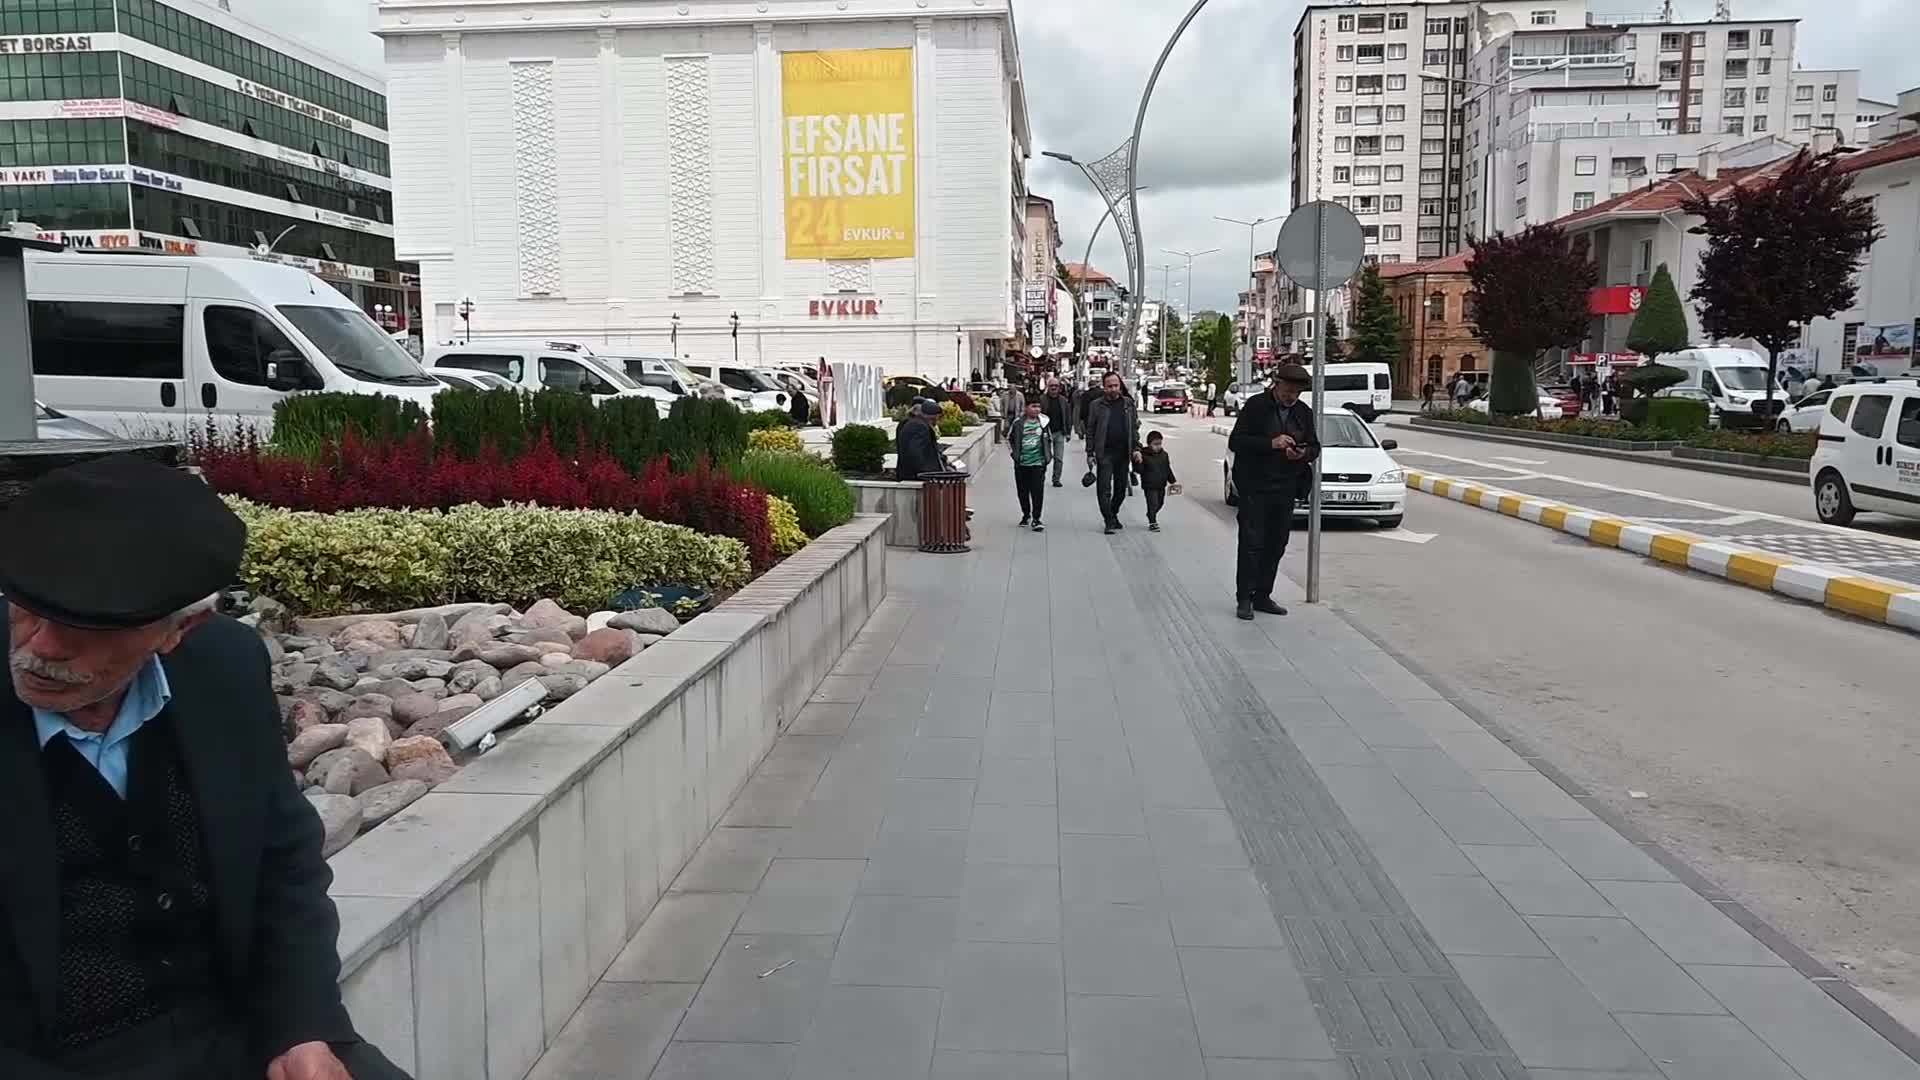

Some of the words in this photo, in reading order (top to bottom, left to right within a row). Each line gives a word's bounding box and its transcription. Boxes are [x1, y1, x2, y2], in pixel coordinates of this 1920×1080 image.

[787, 113, 906, 154] EFSANE
[14, 171, 47, 182] VAKFI
[789, 153, 908, 197] FIRSAT
[843, 227, 891, 241] EVKUR
[808, 299, 880, 317] EVKUR
